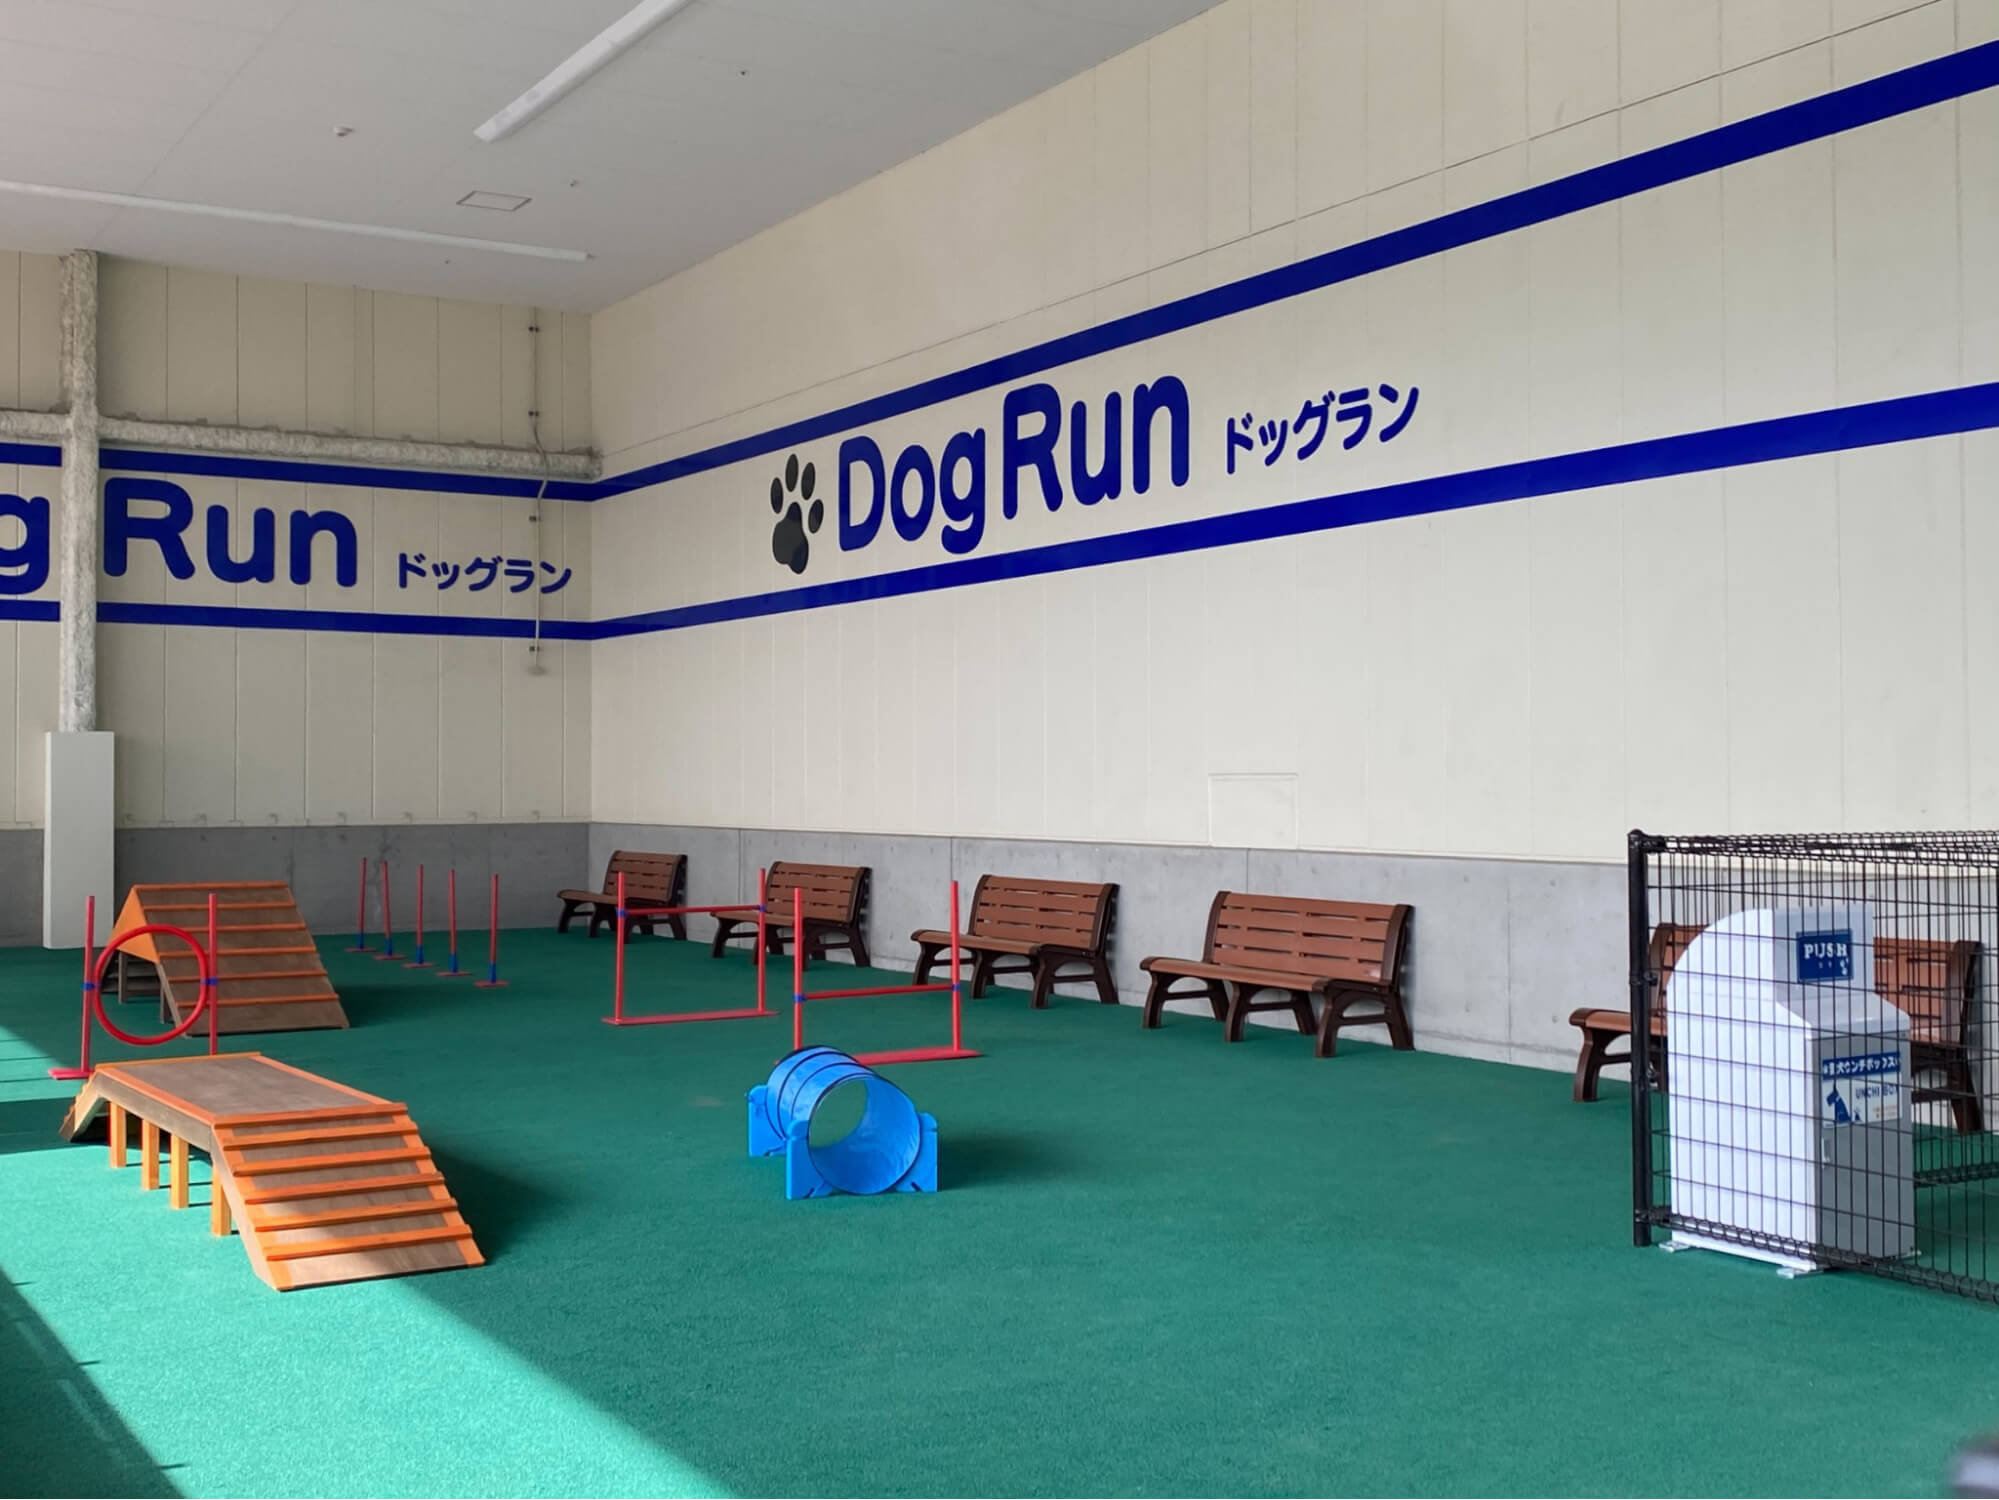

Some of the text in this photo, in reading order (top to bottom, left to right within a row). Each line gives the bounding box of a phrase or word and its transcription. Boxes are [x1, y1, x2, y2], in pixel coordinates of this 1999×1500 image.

[838, 375, 1191, 555] Dog Run
[1226, 383, 1419, 475] ドッグラン
[103, 477, 358, 588] Run
[399, 552, 573, 594] ドッグラン
[1803, 941, 1848, 959] PUSH
